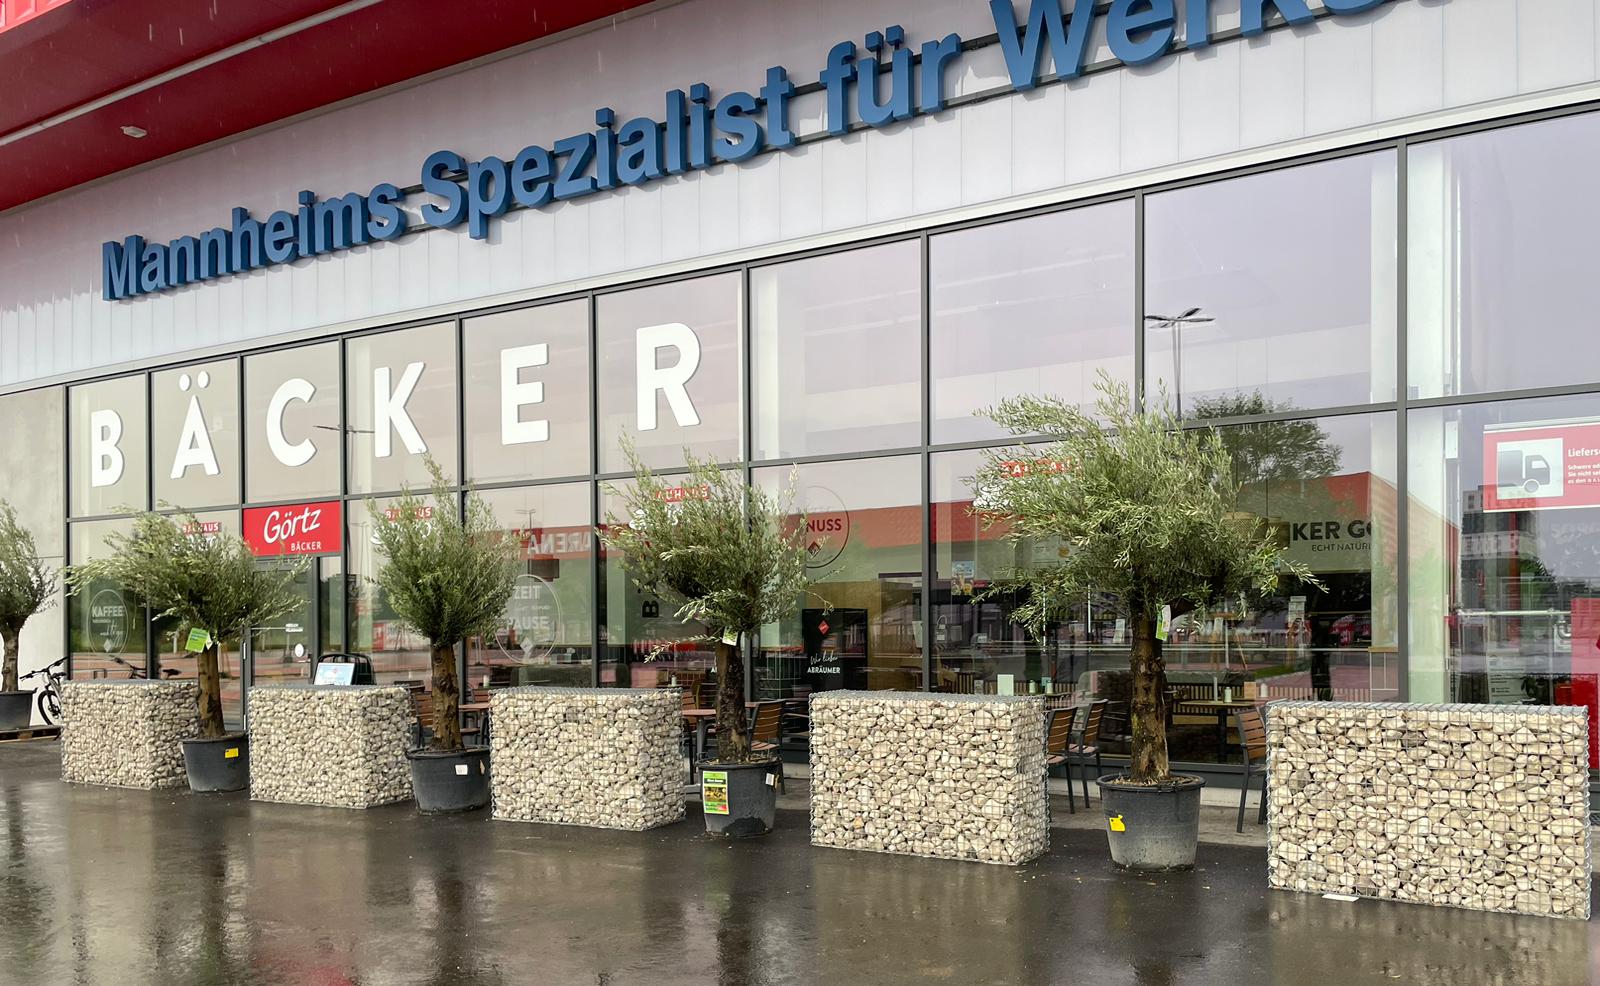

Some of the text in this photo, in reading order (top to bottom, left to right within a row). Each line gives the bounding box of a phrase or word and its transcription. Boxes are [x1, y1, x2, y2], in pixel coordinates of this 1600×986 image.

[103, 183, 407, 301] Mannheims
[421, 65, 796, 241] Spezialist
[820, 24, 962, 137] für
[90, 321, 702, 488] BÄCKER
[1568, 448, 1600, 457] Liefers
[263, 507, 321, 544] Görtz
[291, 541, 322, 552] BÄCKER
[1311, 543, 1336, 552] ECHT
[513, 585, 542, 599] ZEIT
[91, 605, 124, 618] KAFFEE
[505, 615, 551, 634] PAUSE
